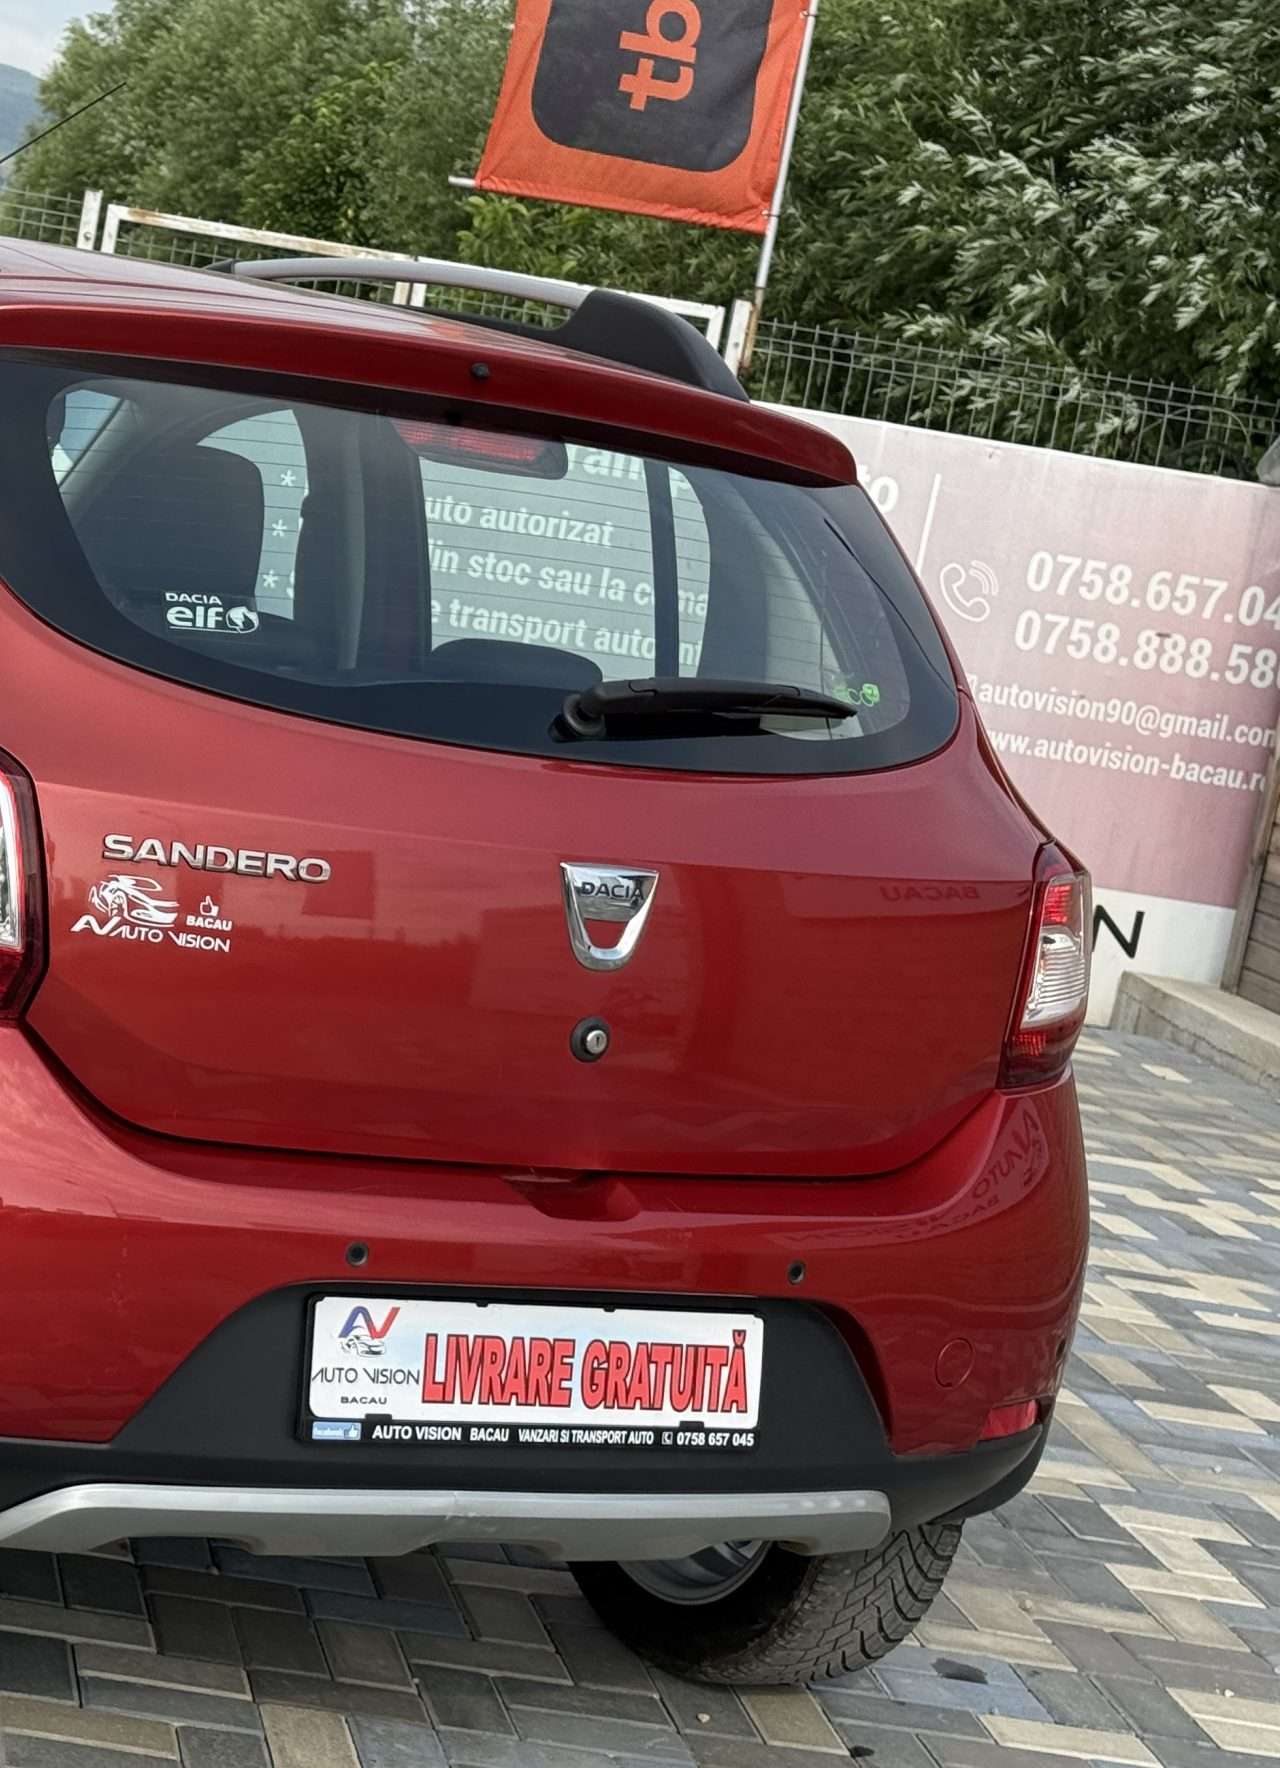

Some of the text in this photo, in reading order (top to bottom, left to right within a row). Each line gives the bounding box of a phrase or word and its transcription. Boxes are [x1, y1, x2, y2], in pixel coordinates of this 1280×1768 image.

[479, 508, 614, 548] autorizat
[467, 550, 531, 586] stoc
[538, 565, 592, 596] sau
[599, 567, 625, 602] la
[165, 592, 222, 605] DACIA
[166, 606, 223, 628] elf
[449, 598, 586, 647] transport
[1014, 609, 1280, 690] 0758.888.58
[103, 834, 331, 882] SANDERO
[581, 882, 644, 900] DACIA
[186, 915, 233, 931] BACAU
[110, 925, 231, 953] AUTO VISION
[311, 1367, 420, 1386] AUTO VISION
[422, 1329, 748, 1413] LIVRARE GRATUITĂ
[340, 1396, 388, 1405] BACAU
[372, 1425, 754, 1446] AUTO VISION BACAU VANZARI SI TRANSPORT AUTO 0758 657 045
